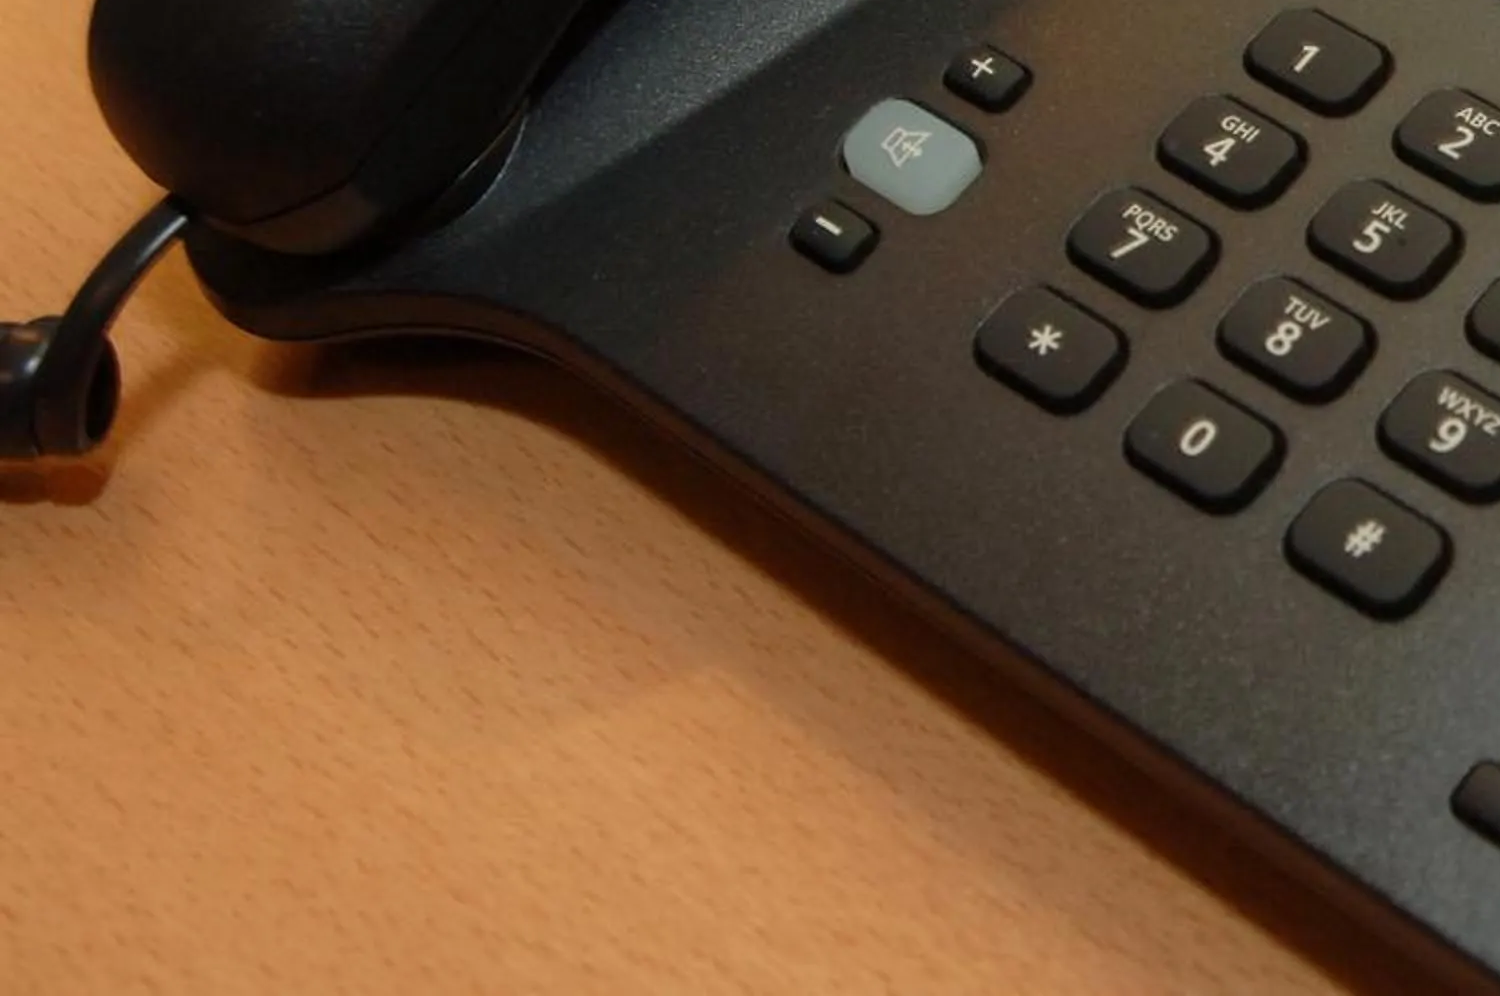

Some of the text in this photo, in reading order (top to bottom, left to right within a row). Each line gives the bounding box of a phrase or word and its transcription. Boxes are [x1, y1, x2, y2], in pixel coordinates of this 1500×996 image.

[1293, 43, 1322, 73] 1
[1219, 114, 1261, 144] GHI
[1437, 125, 1476, 160] 2
[1202, 137, 1237, 167] 4
[1121, 203, 1179, 244] PQRS
[1370, 201, 1409, 231] JKL
[1108, 227, 1150, 260] 7
[1352, 219, 1392, 255] 5
[1283, 295, 1332, 331] TUV
[1264, 320, 1302, 357] 8
[1178, 418, 1217, 458] 0
[1428, 416, 1468, 454] 9
